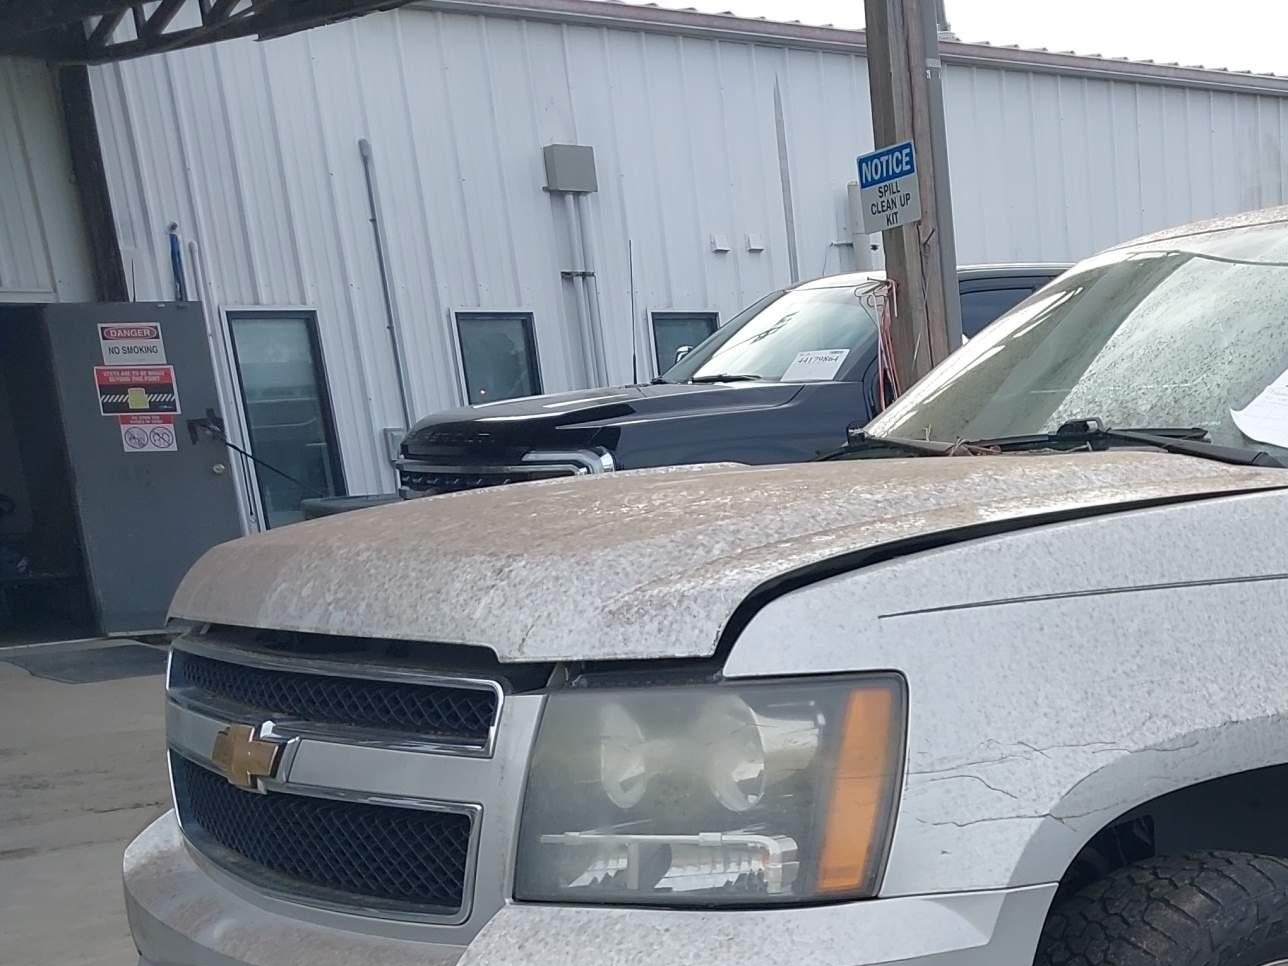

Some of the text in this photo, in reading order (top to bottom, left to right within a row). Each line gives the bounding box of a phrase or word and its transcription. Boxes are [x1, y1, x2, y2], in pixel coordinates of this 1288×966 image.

[862, 148, 911, 184] NOTICE
[878, 181, 901, 198] SPILL
[871, 193, 911, 215] CLEAN UP
[886, 211, 898, 226] KIT
[109, 328, 151, 337] DANGER
[109, 345, 158, 355] NO SMOKING
